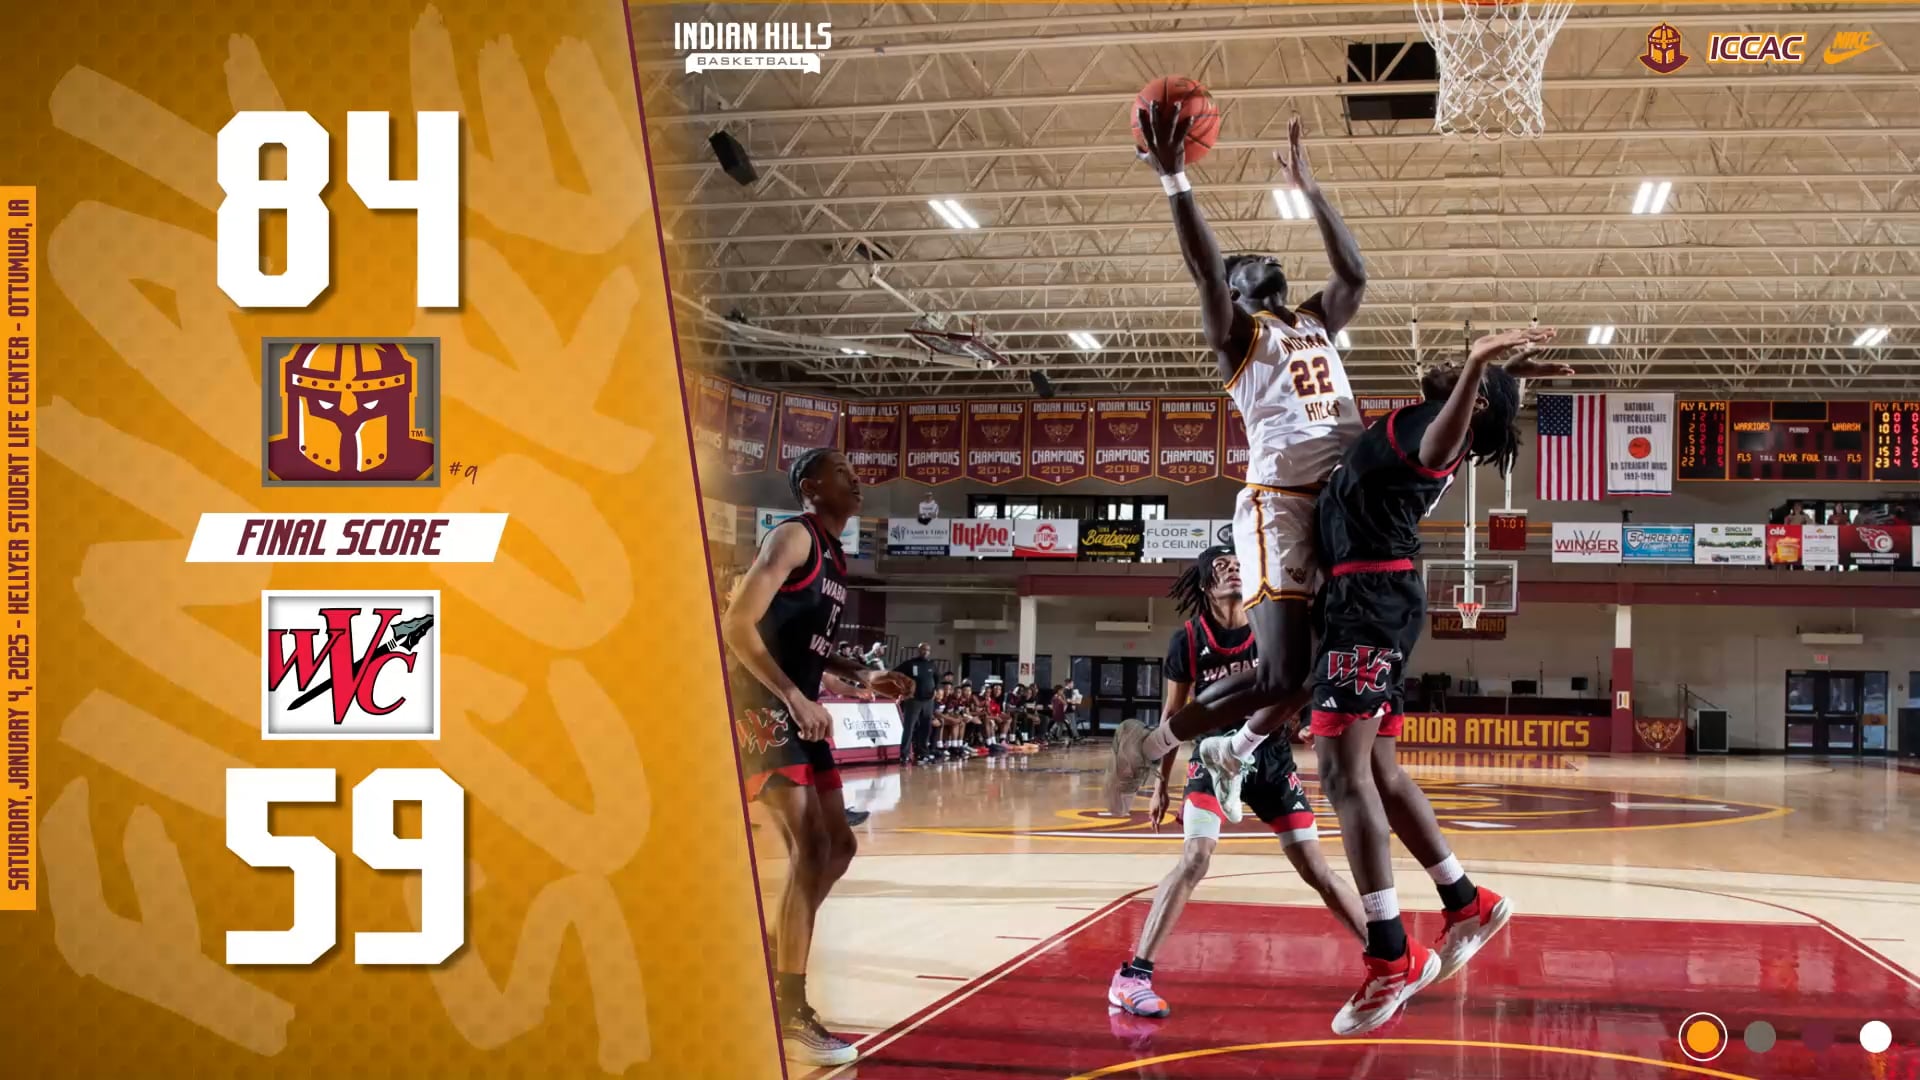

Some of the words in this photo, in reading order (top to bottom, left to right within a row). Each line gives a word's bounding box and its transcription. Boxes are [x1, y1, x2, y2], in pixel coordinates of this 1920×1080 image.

[1280, 333, 1328, 355] INDIAN
[1290, 356, 1336, 398] 22
[749, 392, 772, 407] HILLS
[1361, 399, 1391, 409] INDIAN
[815, 400, 838, 413] HILLS
[908, 404, 936, 414] INDIAN
[937, 404, 960, 414] HILLS
[970, 403, 999, 413] INDIAN
[1000, 403, 1023, 413] HILLS
[1033, 402, 1062, 412] INDIAN
[1063, 402, 1086, 412] HILLS
[1097, 401, 1126, 412] INDIAN
[1127, 401, 1151, 411] HILLS
[1162, 402, 1191, 412] INDIAN
[1192, 402, 1216, 412] HILLS
[1624, 402, 1654, 412] NATIONAL
[1680, 402, 1695, 411] PLY
[1698, 402, 1708, 411] FL
[1709, 402, 1725, 411] PTS
[1874, 402, 1889, 411] PLY
[1892, 403, 1902, 411] FL
[1904, 403, 1920, 411] PTS
[1612, 413, 1667, 423] INTERCOLLEGIATE
[1882, 412, 1890, 422] 0
[1893, 412, 1901, 422] 0
[1911, 412, 1919, 422] 0
[1627, 425, 1652, 435] RECORD
[1688, 423, 1695, 433] 2
[1733, 422, 1770, 432] WARRIORS
[1832, 422, 1861, 432] WABASH
[1879, 423, 1890, 433] 10
[1893, 423, 1901, 433] 0
[1911, 423, 1919, 433] 5
[1688, 434, 1695, 444] 5
[1699, 434, 1706, 444] 2
[1879, 435, 1890, 445] 11
[1911, 434, 1919, 445] 6
[1685, 445, 1695, 455] 13
[1879, 446, 1890, 456] 15
[1894, 446, 1901, 456] 3
[1911, 446, 1919, 456] 2
[847, 452, 899, 467] CHAMPIONS
[907, 451, 960, 466] CHAMPIONS
[968, 450, 1021, 466] CHAMPIONS
[1031, 450, 1085, 465] CHAMPIONS
[1096, 449, 1150, 465] CHAMPIONS
[1160, 450, 1215, 465] CHAMPIONS
[1681, 456, 1695, 467] 22
[1736, 453, 1752, 462] FLS
[1778, 453, 1798, 462] PLYR
[1802, 453, 1820, 462] FOUL
[1847, 453, 1862, 462] FLS
[1620, 461, 1650, 471] STRAIGHT
[1874, 457, 1890, 468] 23
[1893, 457, 1901, 467] 4
[1911, 457, 1919, 468] 5
[917, 466, 949, 475] 2012
[977, 466, 1012, 475] 2014
[1041, 466, 1075, 474] 2015
[1105, 465, 1140, 473] 2018
[1168, 465, 1207, 474] 2023
[1146, 528, 1188, 537] FLOOR
[1769, 526, 1786, 536] olé
[1081, 529, 1140, 549] Barbecue
[1629, 532, 1690, 543] SCHROEDER
[1147, 540, 1159, 549] to
[1162, 539, 1208, 549] CEILING
[1555, 539, 1618, 550] WINGER
[1433, 617, 1462, 631] JAZZ
[1203, 658, 1260, 682] WABA
[1396, 716, 1456, 744] RIOR
[1464, 717, 1590, 747] ATHLETICS
